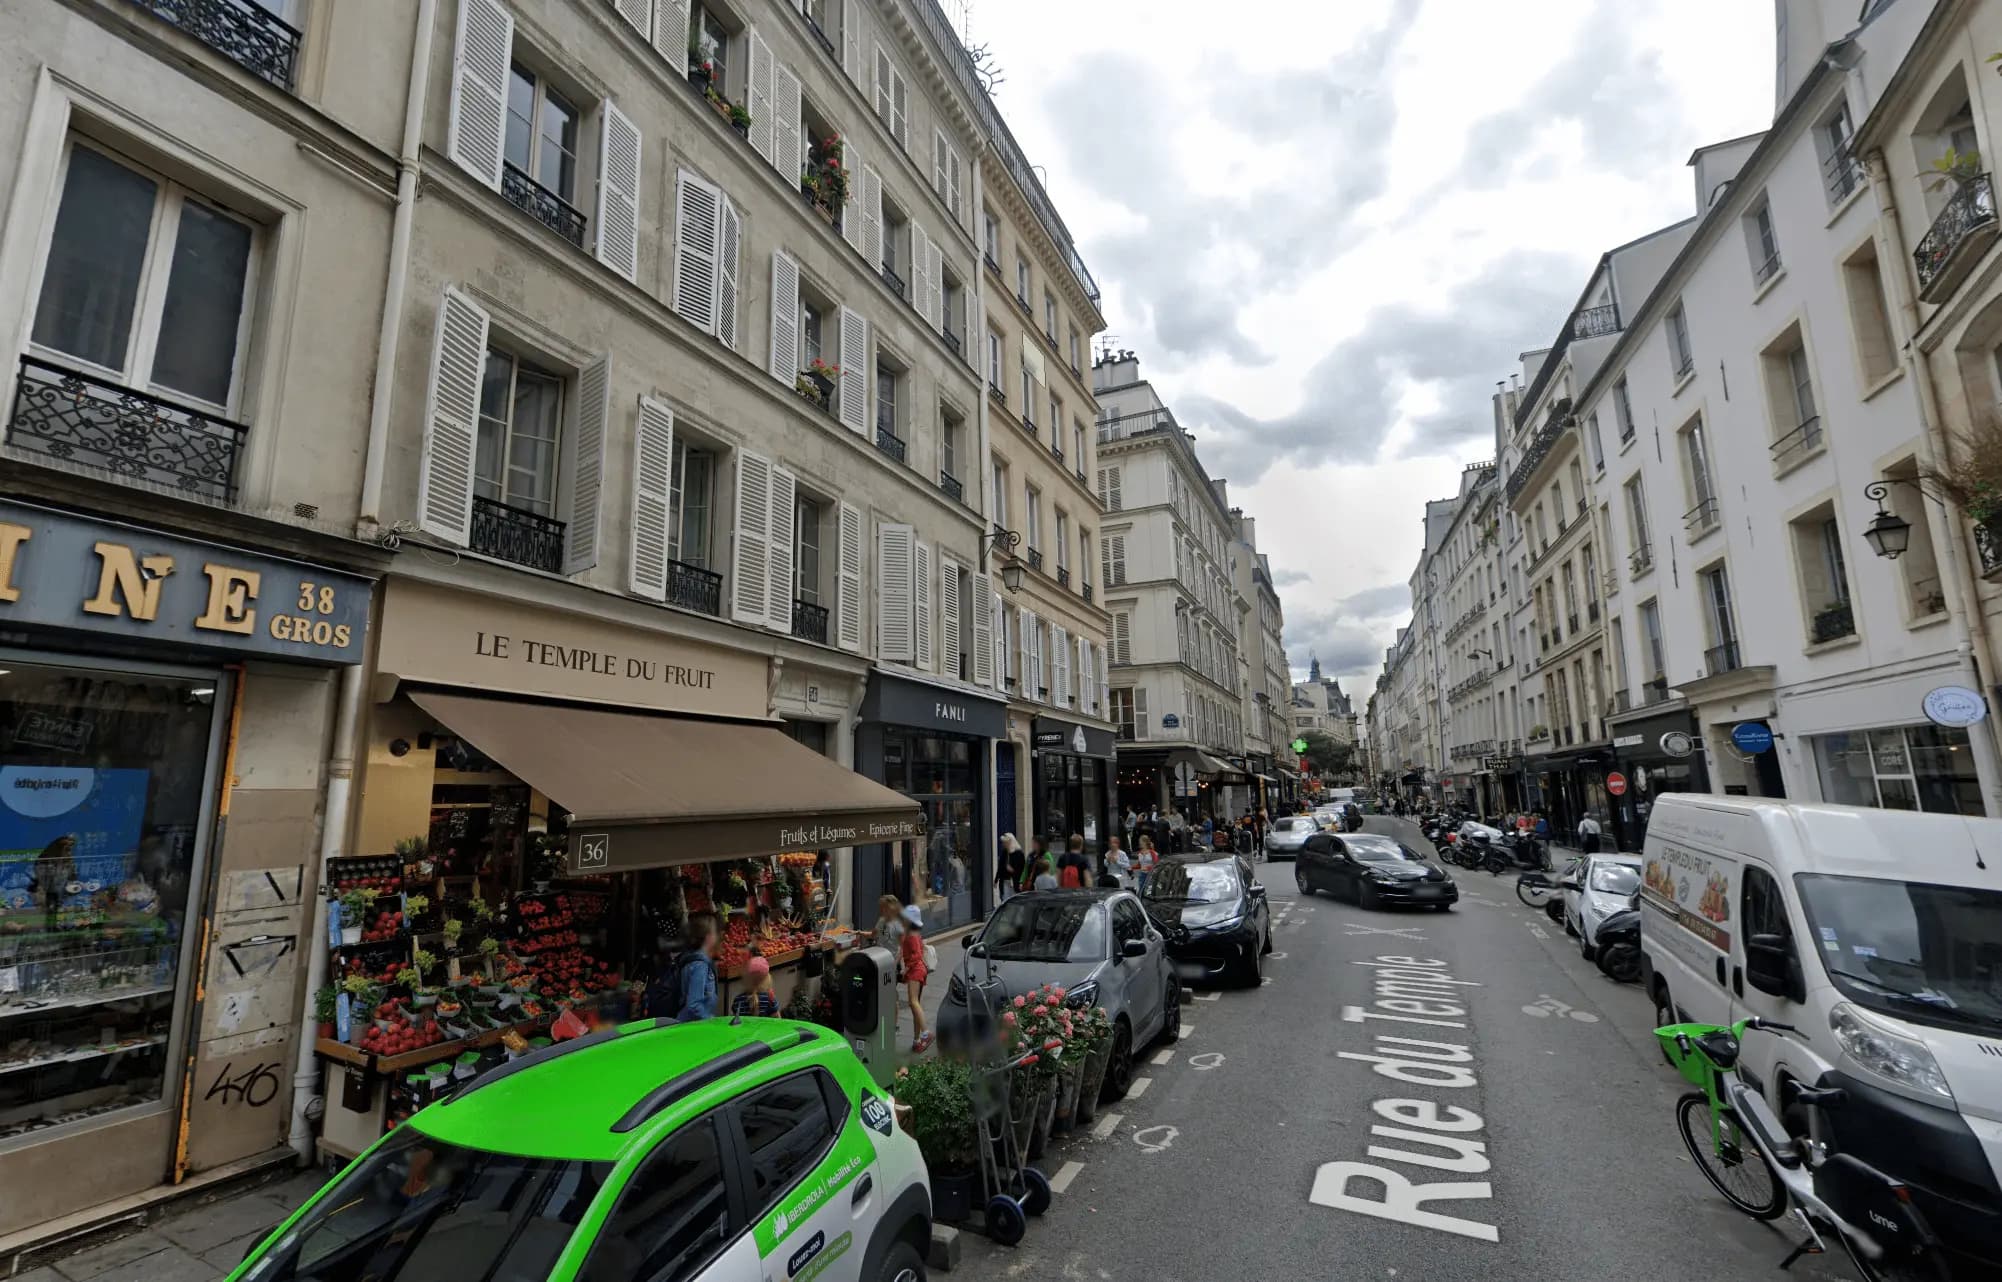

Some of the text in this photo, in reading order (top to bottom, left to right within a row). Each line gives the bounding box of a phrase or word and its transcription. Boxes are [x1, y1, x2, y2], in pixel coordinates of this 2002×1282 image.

[298, 581, 335, 615] 38
[270, 614, 351, 649] GROS
[475, 631, 715, 689] LE TEMPLE DU FRUIT
[935, 703, 966, 722] FANLI
[780, 824, 808, 847] Fruits
[809, 824, 819, 844] et
[820, 825, 857, 842] Légumes
[899, 821, 914, 835] Fine
[582, 840, 605, 862] 36
[864, 1101, 886, 1123] 100
[786, 1185, 825, 1224] IBERDROLA
